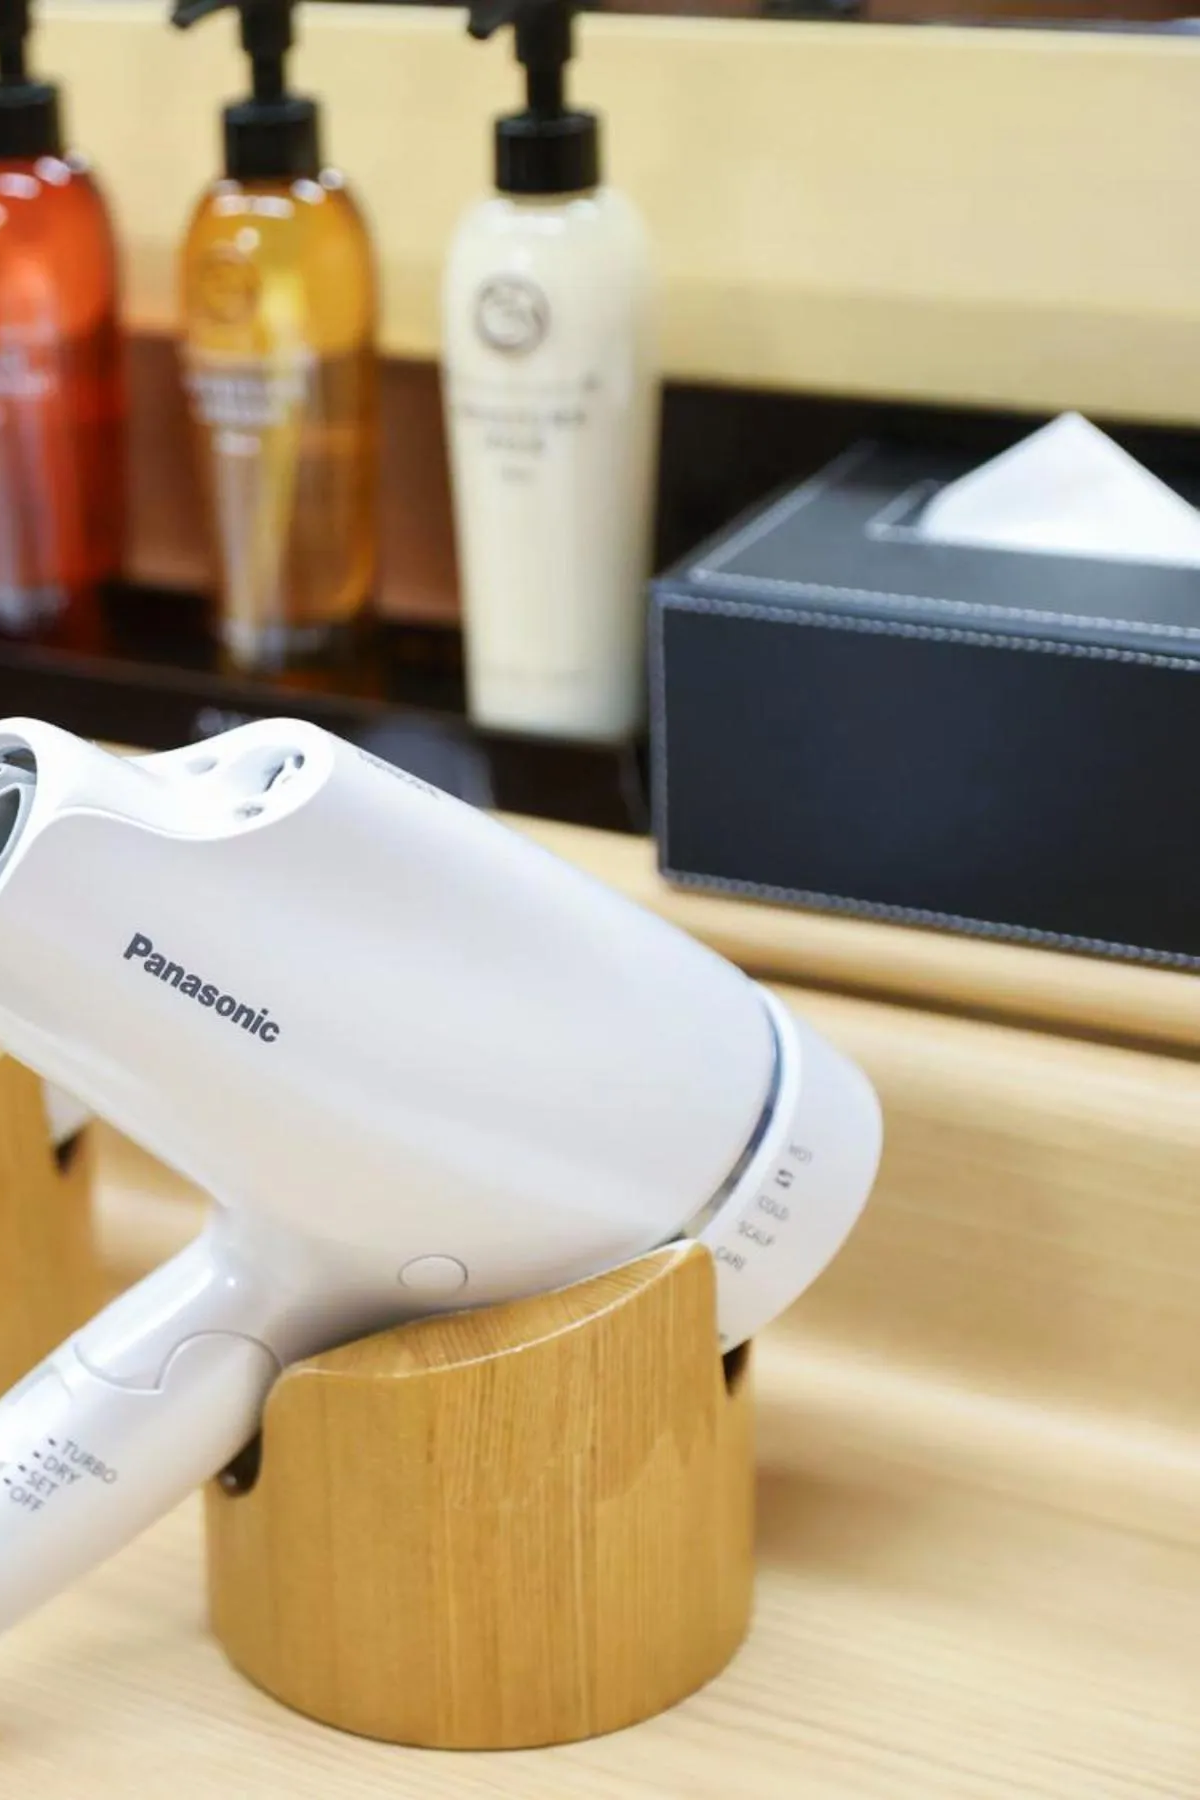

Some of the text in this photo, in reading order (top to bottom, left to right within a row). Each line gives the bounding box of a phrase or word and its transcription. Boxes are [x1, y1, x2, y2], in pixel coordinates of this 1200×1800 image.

[123, 932, 280, 1043] Panasonic
[757, 1194, 790, 1222] COLD
[42, 1454, 83, 1485] DRY
[61, 1439, 118, 1485] TURBO
[25, 1470, 60, 1497] SET
[9, 1485, 46, 1512] OFF
